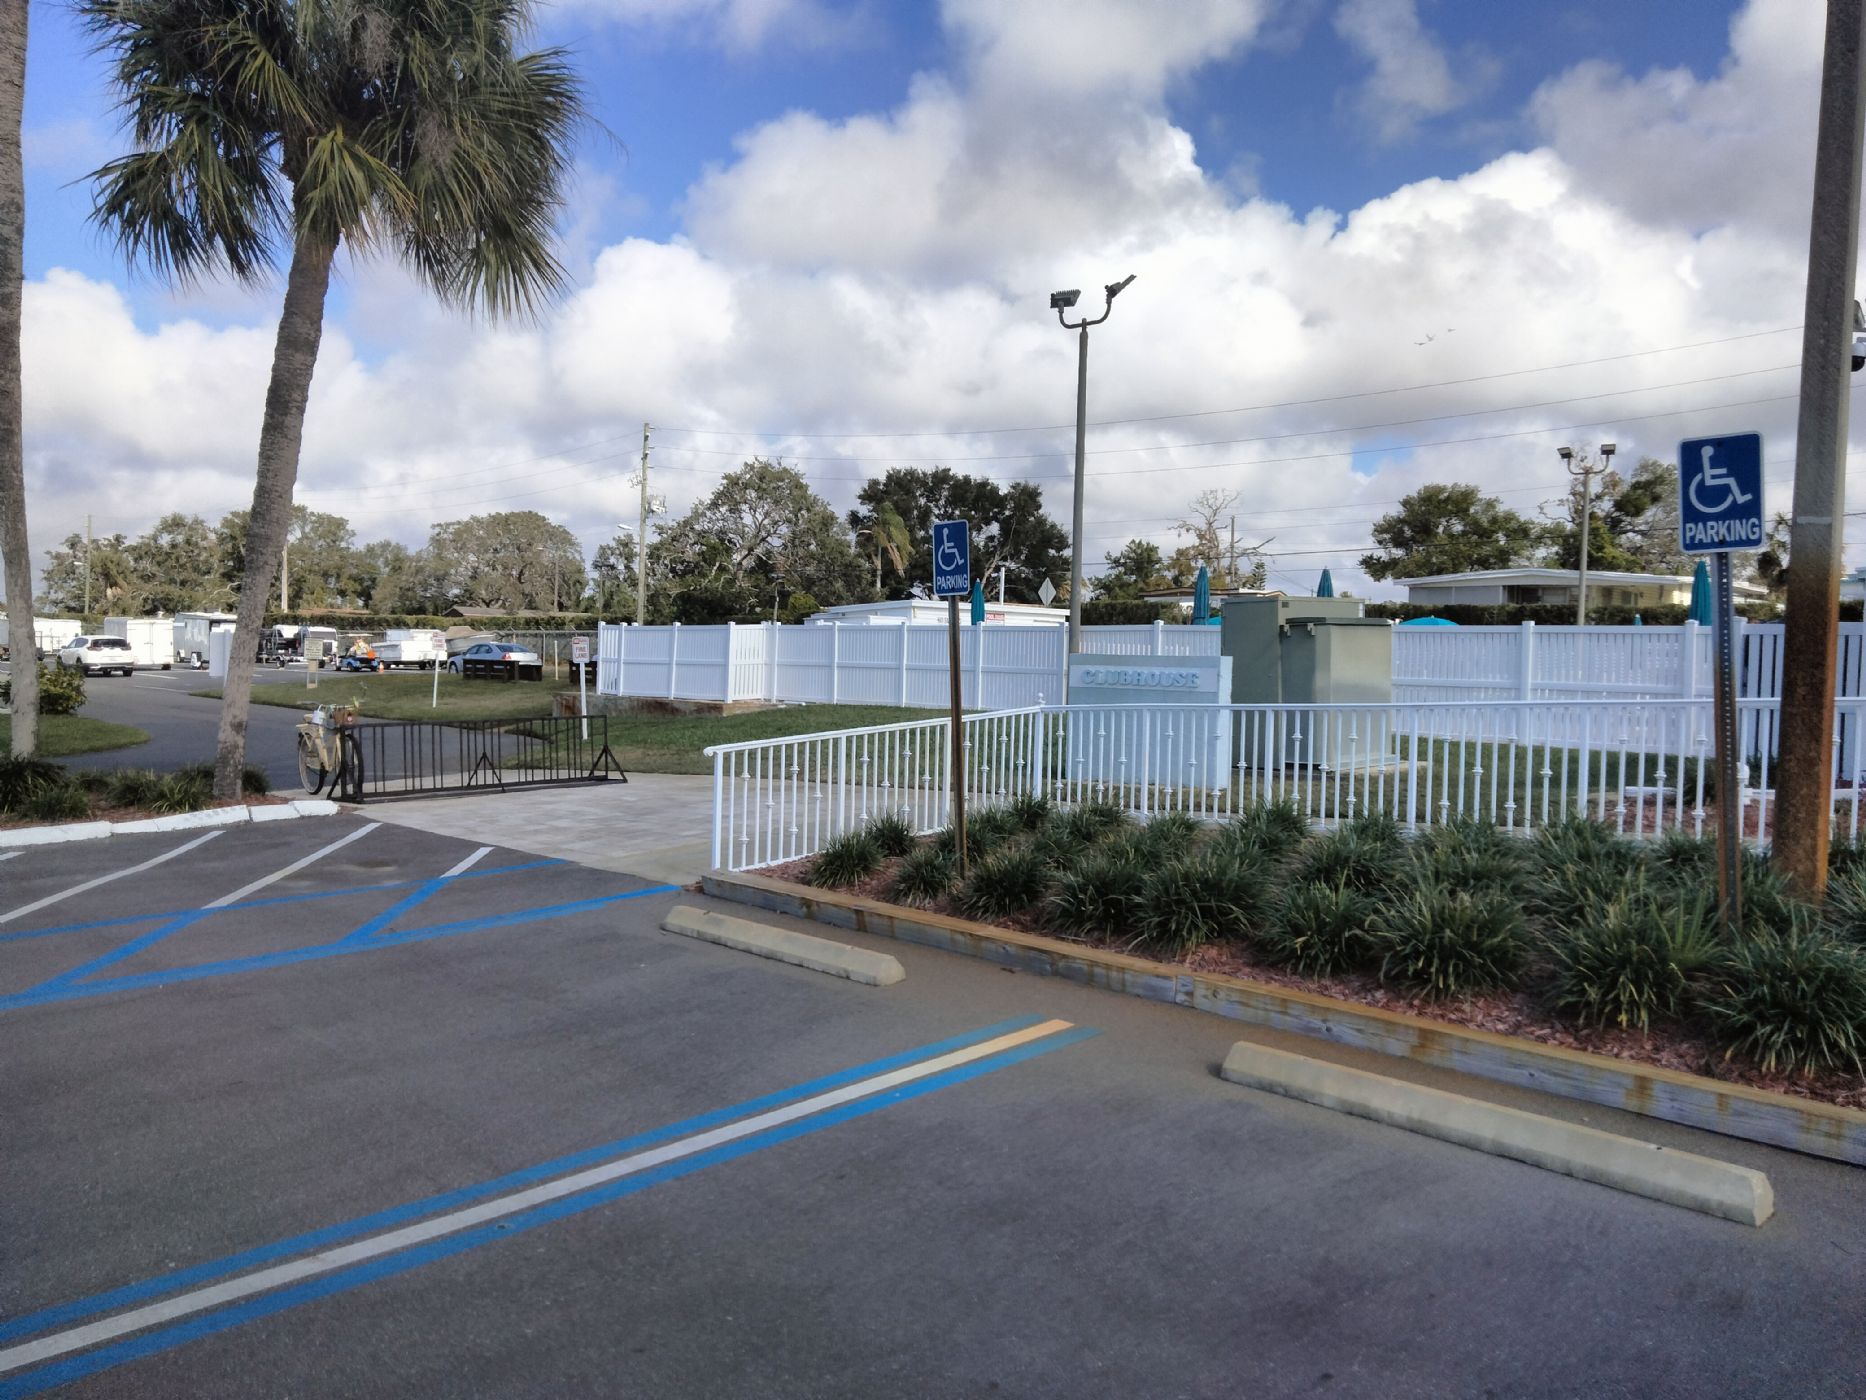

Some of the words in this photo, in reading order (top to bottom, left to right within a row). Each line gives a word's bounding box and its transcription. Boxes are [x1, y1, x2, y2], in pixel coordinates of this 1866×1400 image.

[1685, 517, 1760, 544] PARKING
[936, 574, 968, 590] PARKING
[1081, 669, 1199, 688] CLUBHOUSE
